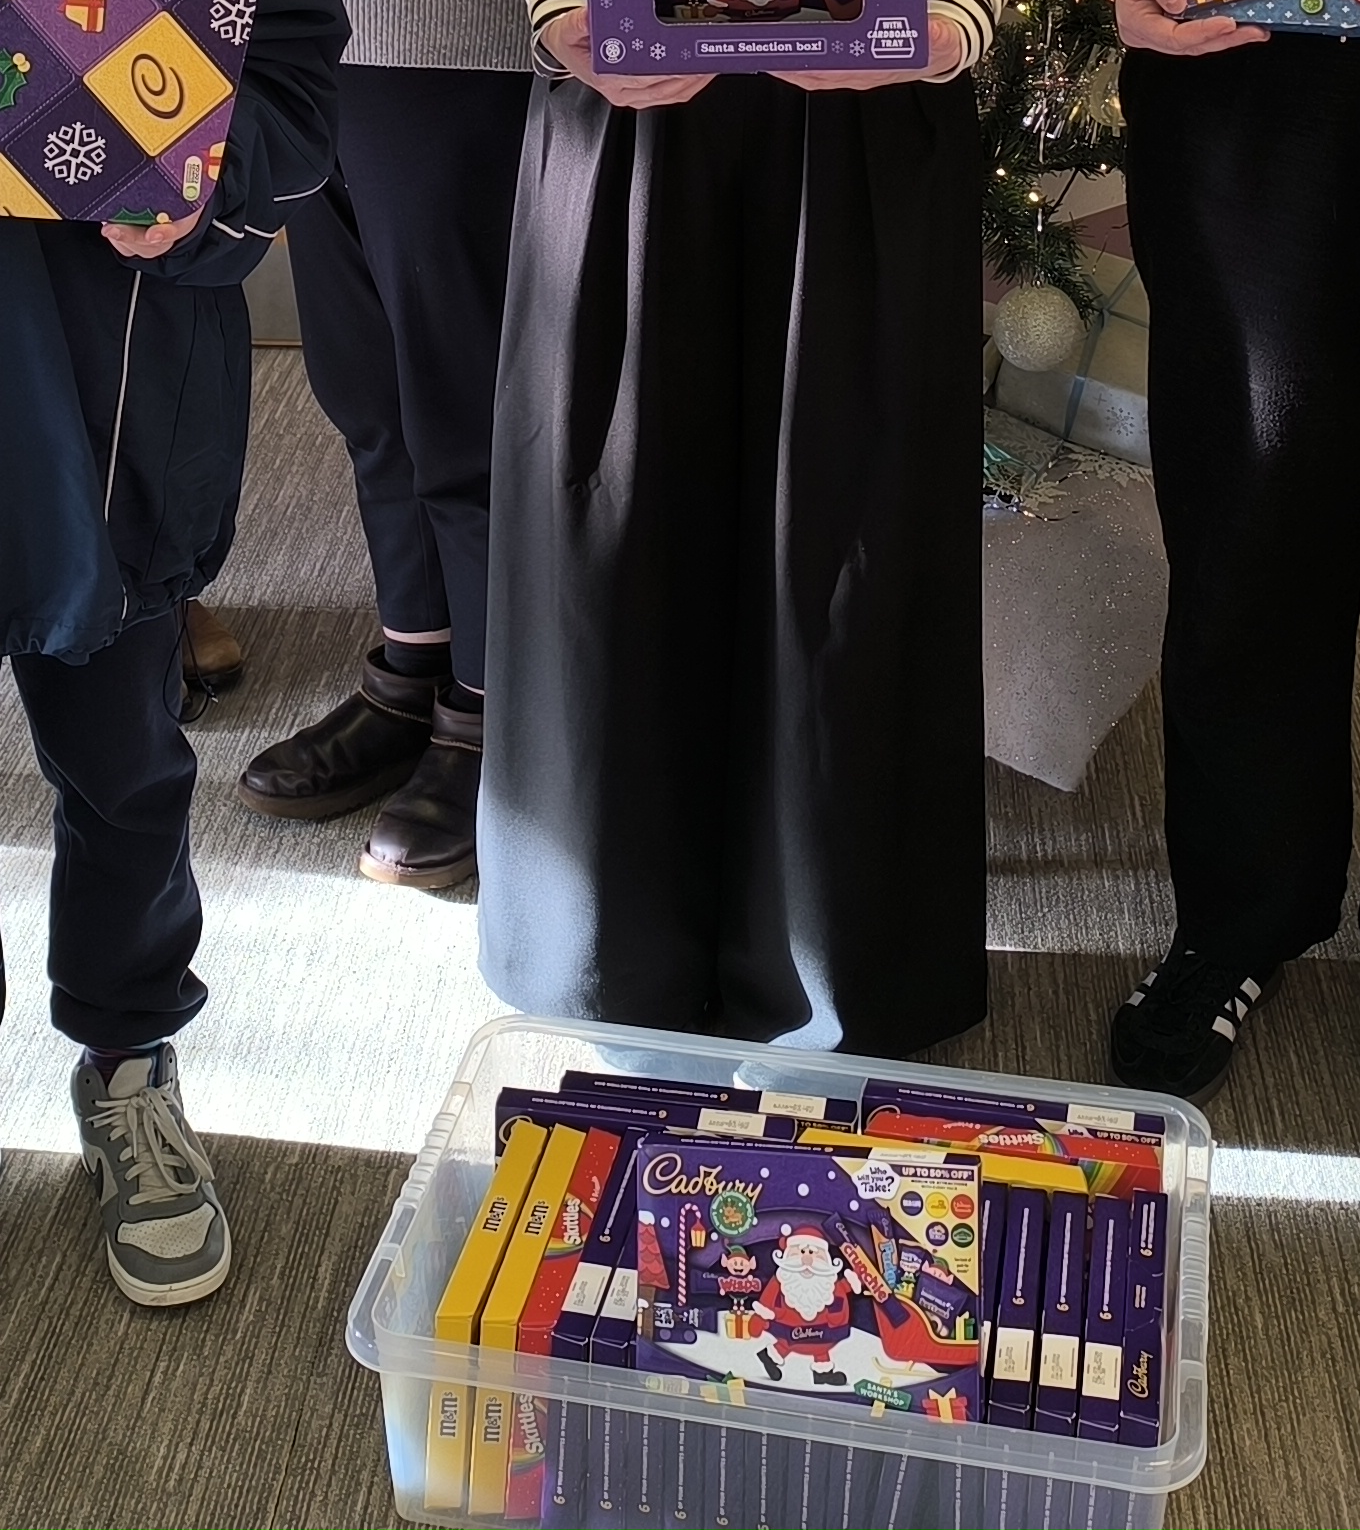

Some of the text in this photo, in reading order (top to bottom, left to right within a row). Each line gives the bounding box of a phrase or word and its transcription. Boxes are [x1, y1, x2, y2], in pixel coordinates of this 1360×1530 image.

[882, 21, 903, 29] WITH
[867, 30, 918, 39] CARDBOARD
[700, 39, 823, 53] Santa Selection box!
[881, 39, 904, 48] TRAY
[978, 1133, 1045, 1147] Skittles
[869, 1167, 887, 1175] Who
[902, 1167, 915, 1175] UP
[916, 1168, 928, 1176] TO
[930, 1168, 950, 1178] 50%
[861, 1176, 894, 1193] Take?
[871, 1175, 884, 1183] you
[563, 1198, 582, 1245] Skittles
[843, 1244, 889, 1300] crunchie
[719, 1277, 760, 1291] Wispa
[1127, 1351, 1153, 1398] Cadbury
[867, 1382, 899, 1398] SANTA'S
[860, 1387, 904, 1406] WORKSHOP
[519, 1393, 544, 1454] Skittles
[554, 1495, 565, 1504] 6
[600, 1500, 612, 1509] 6
[675, 1511, 686, 1519] 6
[716, 1517, 728, 1526] 6
